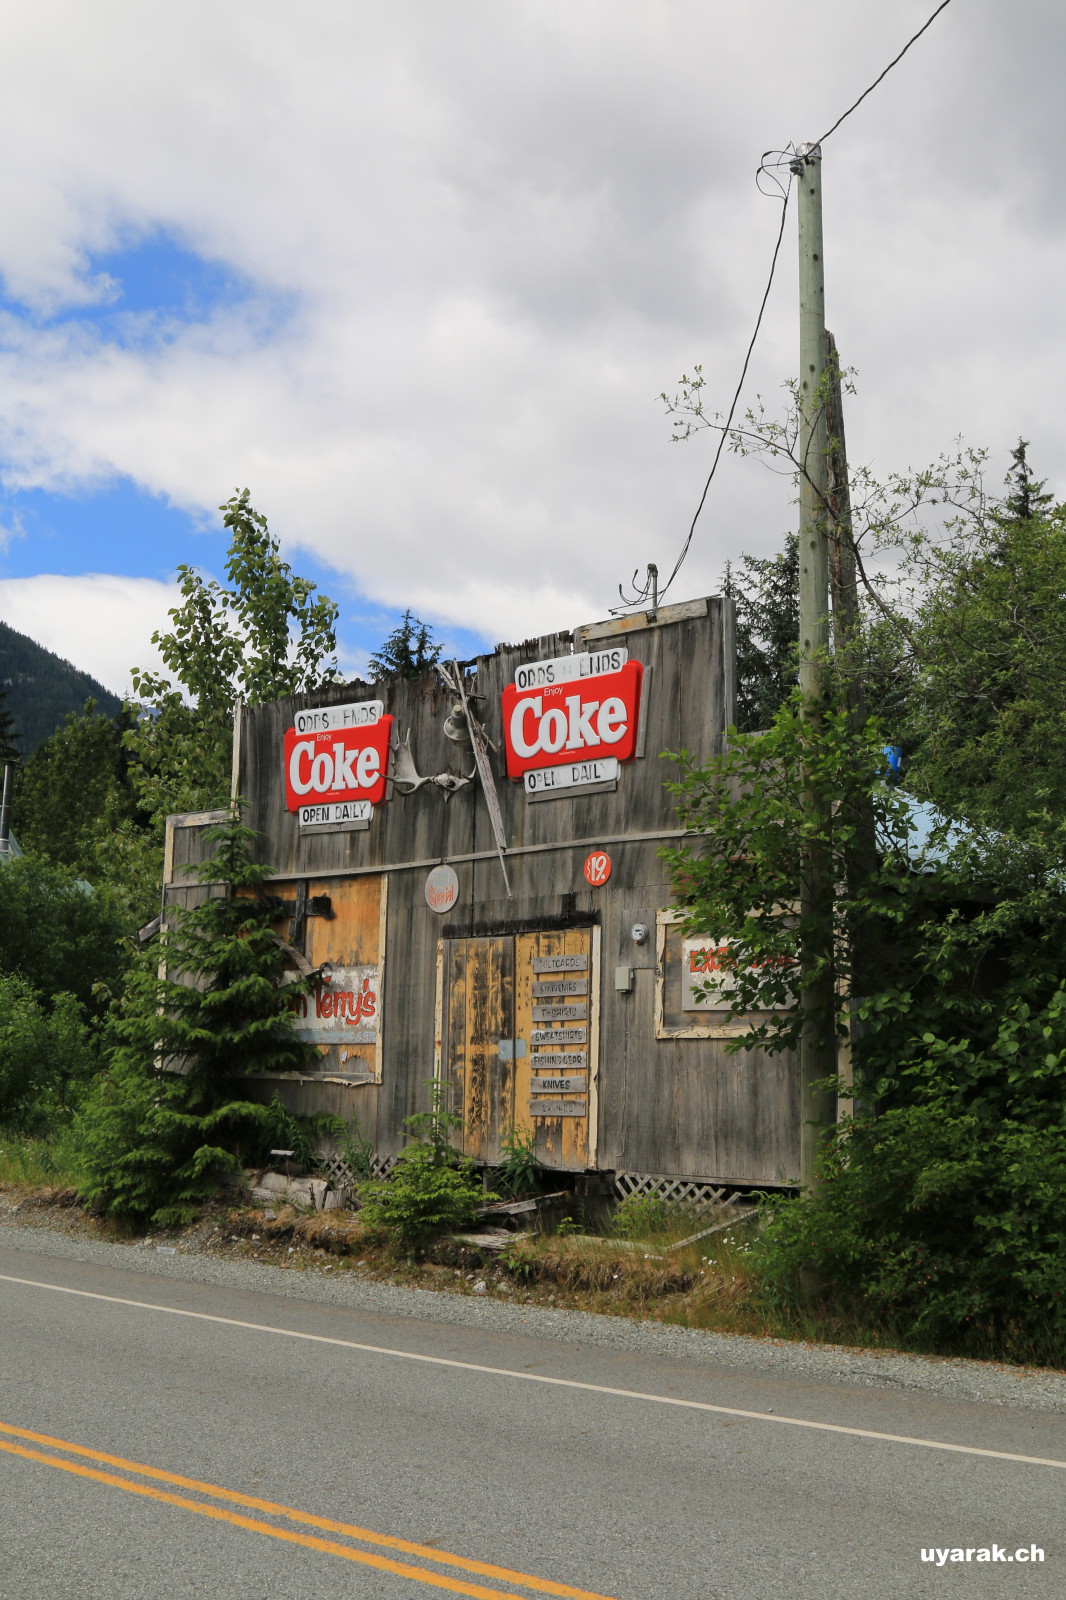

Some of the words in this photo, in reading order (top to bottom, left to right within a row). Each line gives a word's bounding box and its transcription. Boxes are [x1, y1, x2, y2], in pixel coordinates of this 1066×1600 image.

[517, 664, 555, 688] ODDS
[543, 686, 564, 697] Enjoy
[298, 713, 329, 732] ODDS
[343, 706, 377, 726] ENDS
[510, 695, 628, 758] Coke
[316, 733, 333, 741] Enjoy
[289, 740, 381, 795] Coke
[528, 770, 560, 789] OPEN
[572, 762, 609, 782] DAILY
[302, 806, 330, 822] OPEN
[335, 804, 367, 820] DAILY
[539, 958, 580, 969] POSTCARDS
[315, 976, 376, 1025] Terry's
[541, 1007, 577, 1018] T-SHIRTS
[535, 1030, 582, 1041] SWEATSHIRTS
[533, 1055, 561, 1065] FISHING
[563, 1055, 582, 1065] GEAR
[542, 1080, 571, 1090] KNIVES
